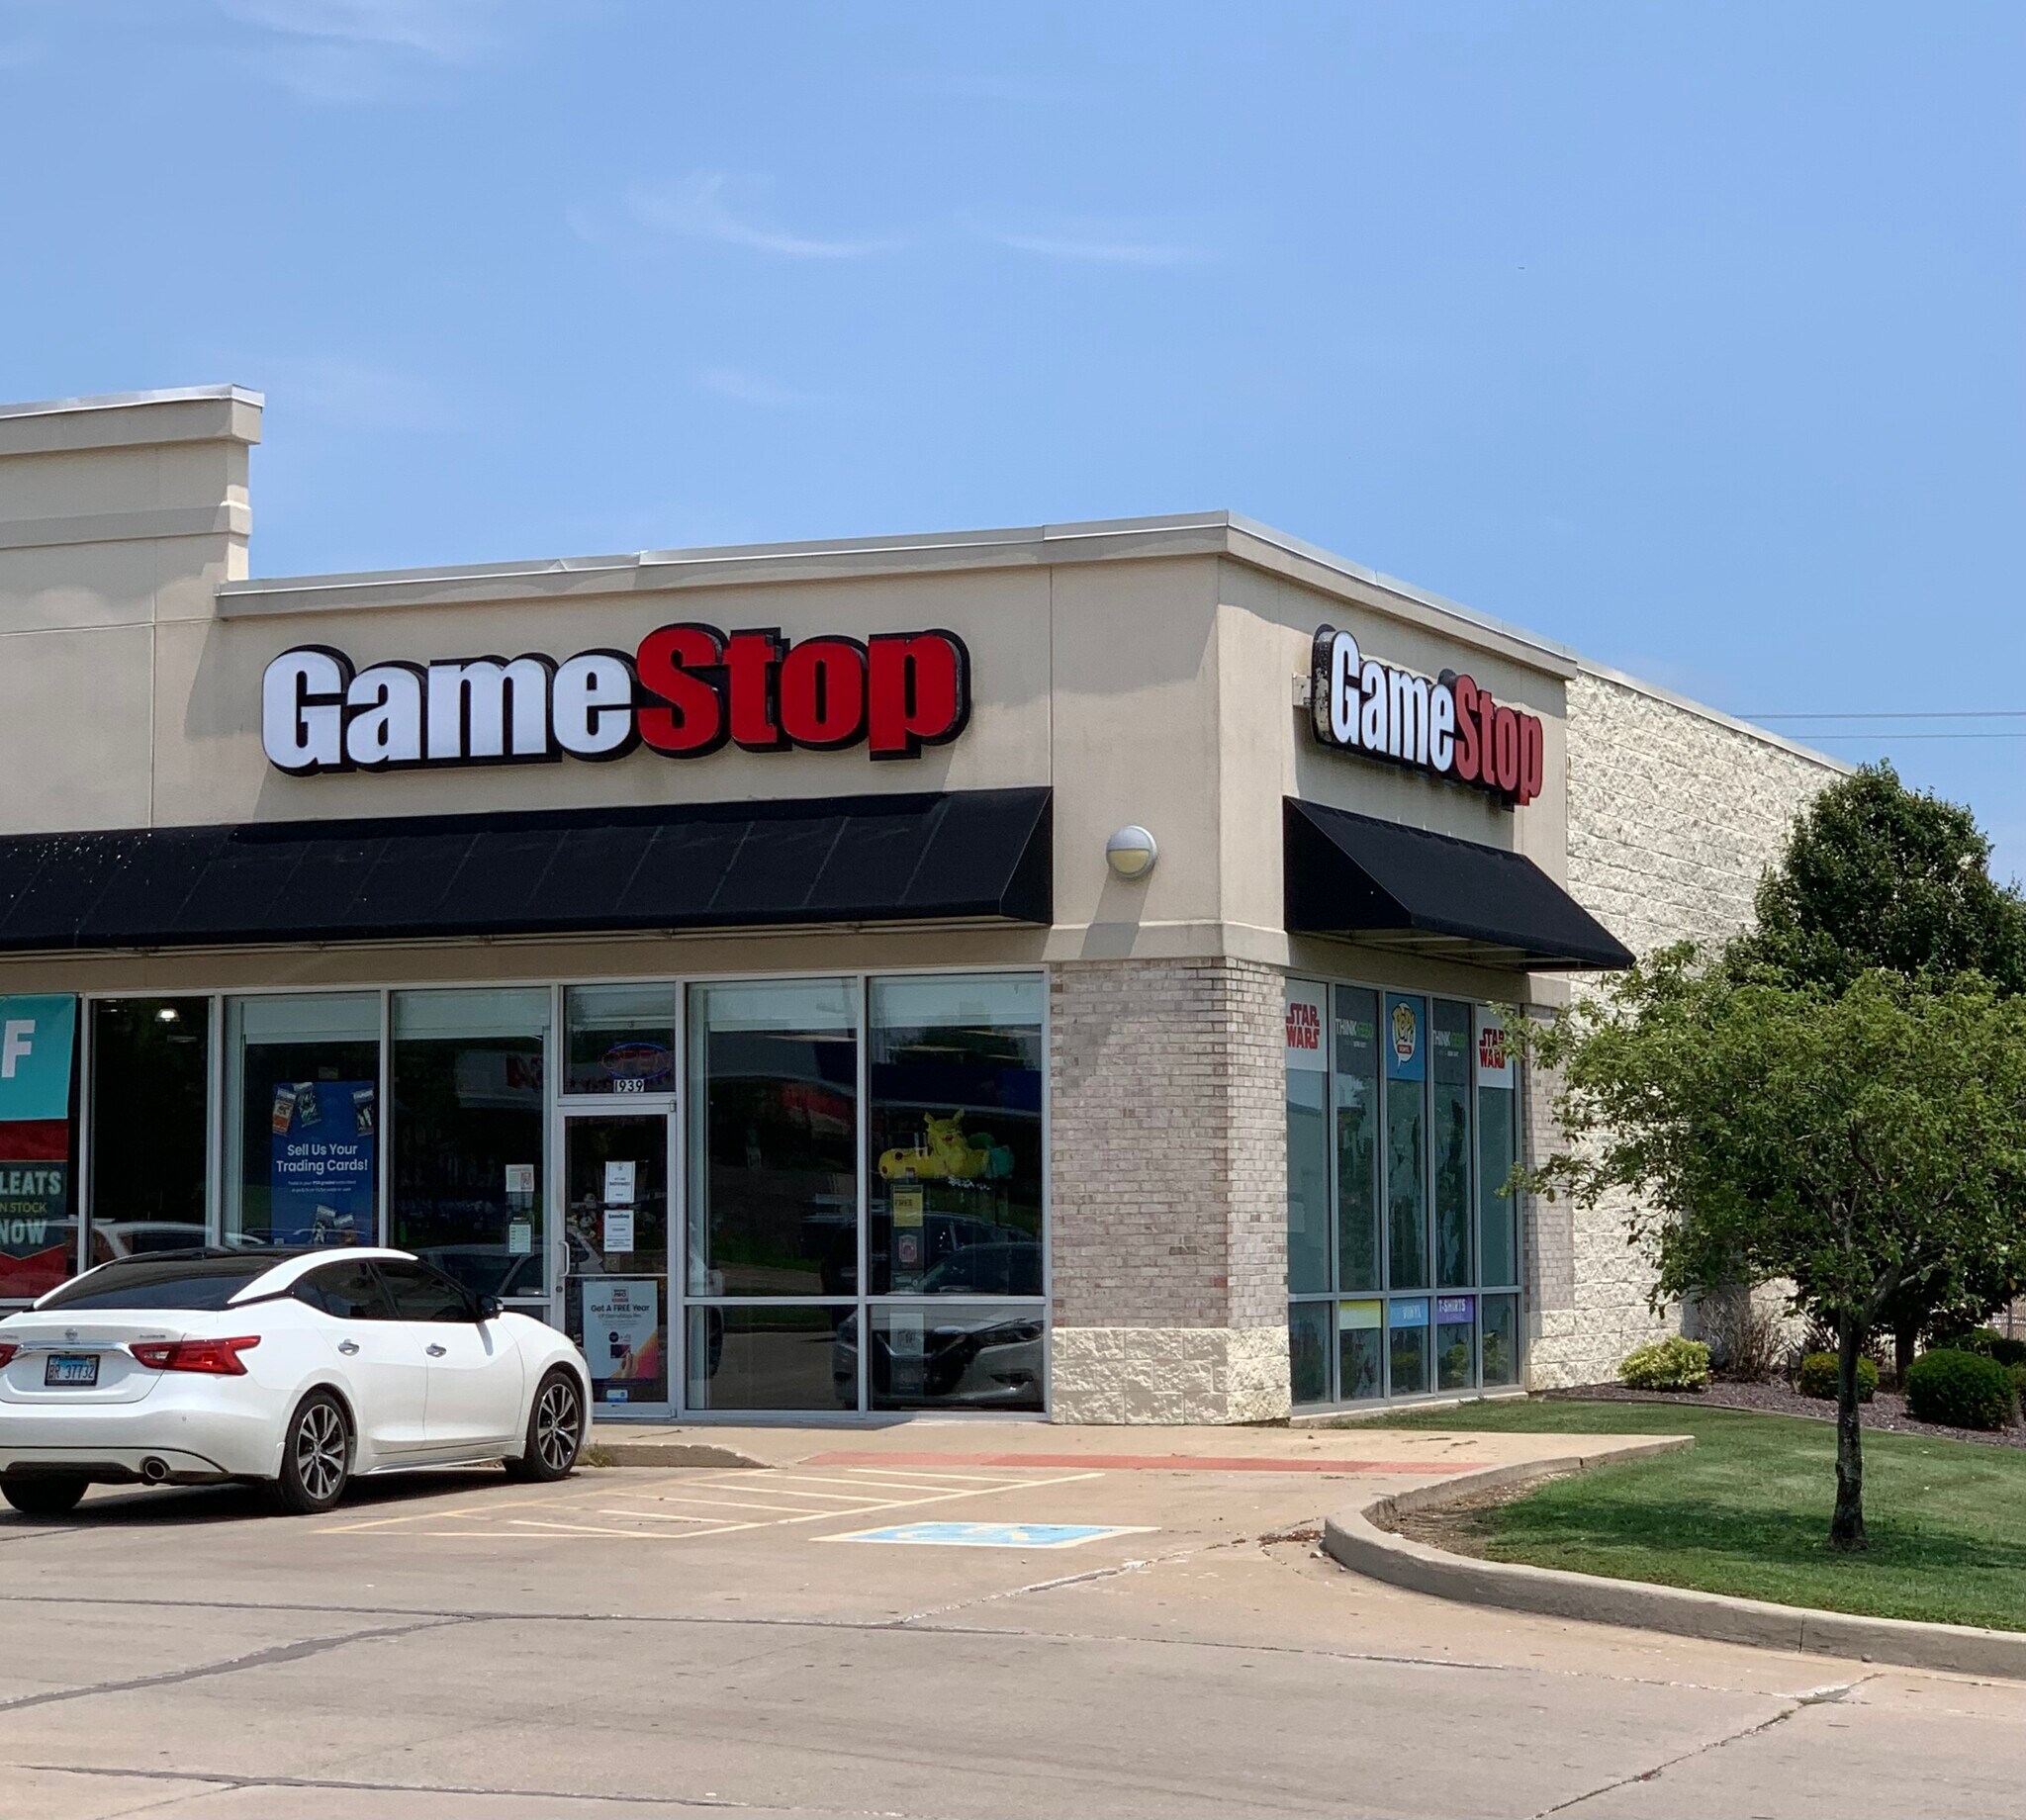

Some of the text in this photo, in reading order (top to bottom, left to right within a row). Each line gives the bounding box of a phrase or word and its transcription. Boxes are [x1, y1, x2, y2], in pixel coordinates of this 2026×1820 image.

[261, 627, 964, 771] GameStop
[1330, 629, 1543, 806] GameStop
[1286, 1002, 1321, 1028] STAR
[1285, 1025, 1321, 1050] WARS
[287, 1143, 358, 1156] Sell Us Your
[276, 1158, 368, 1176] Trading Cards!
[10, 1202, 47, 1214] STOCK
[591, 1304, 604, 1313] Get
[613, 1304, 630, 1313] FREE
[1437, 1298, 1466, 1314] T-SHIRTS
[48, 1364, 60, 1379] BR
